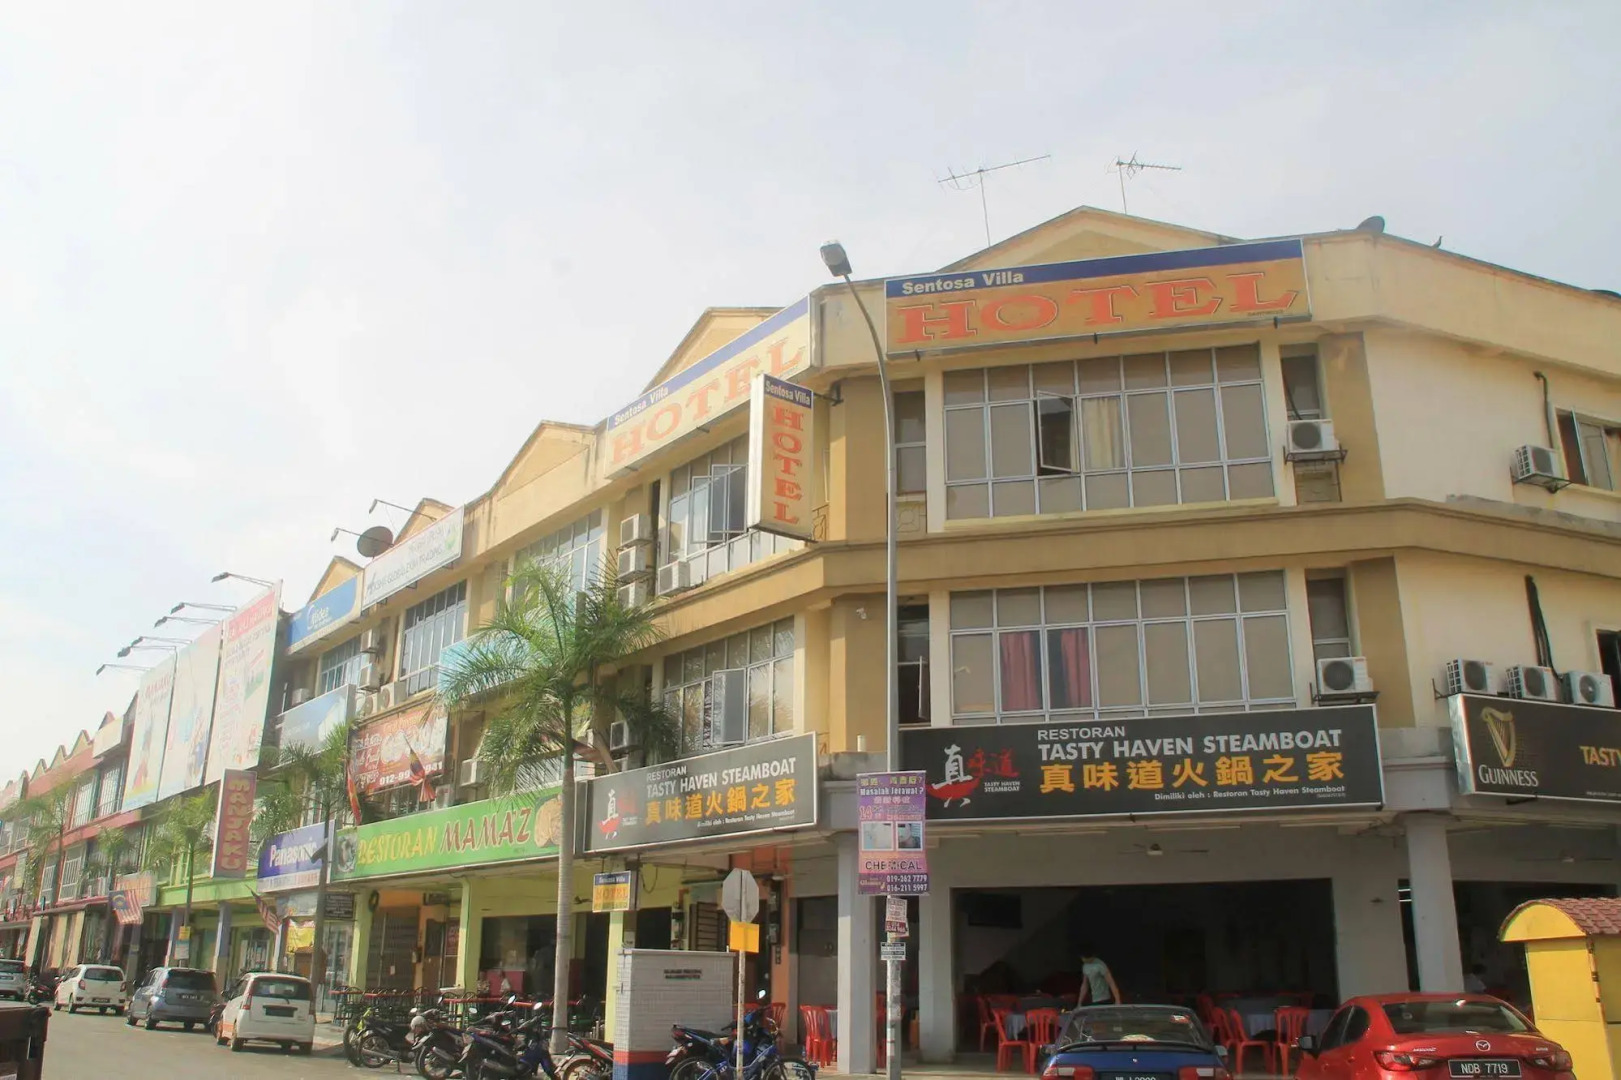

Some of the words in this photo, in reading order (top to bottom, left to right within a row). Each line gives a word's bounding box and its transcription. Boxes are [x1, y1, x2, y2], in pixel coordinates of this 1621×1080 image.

[902, 276, 975, 295] Sentosa
[982, 269, 1024, 286] Villa
[896, 272, 1298, 344] HOTEL
[611, 337, 806, 465] HOTEL
[614, 400, 648, 427] Sentosa
[649, 385, 669, 405] Villa
[765, 380, 794, 401] Sentosa
[794, 389, 811, 406] Villa
[772, 403, 804, 525] HOTEL
[1037, 726, 1125, 741] RESTORAN
[1037, 741, 1104, 761] TASTY
[1113, 737, 1193, 758] HAVEN
[1203, 729, 1342, 753] STEAMBOAT
[379, 769, 411, 786] 012-99
[646, 765, 687, 782] RESTORAN
[646, 780, 676, 799] TASTY
[680, 771, 718, 793] HAVEN
[721, 757, 797, 785] STEAMBOAT
[1039, 751, 1345, 793] 真味道火鍋之家
[1478, 764, 1539, 787] GUINNESS
[645, 778, 797, 827] 真味道火鍋之家
[1154, 791, 1186, 800] Dimiliki
[1188, 791, 1206, 799] oleh
[1213, 790, 1248, 798] Restoran
[1250, 788, 1271, 798] Tasty
[1273, 786, 1299, 795] Haven
[1301, 785, 1345, 794] Steamboat
[357, 826, 438, 866] RESTORAN
[1460, 1063, 1481, 1074] NDB
[1485, 1063, 1509, 1074] 7719
